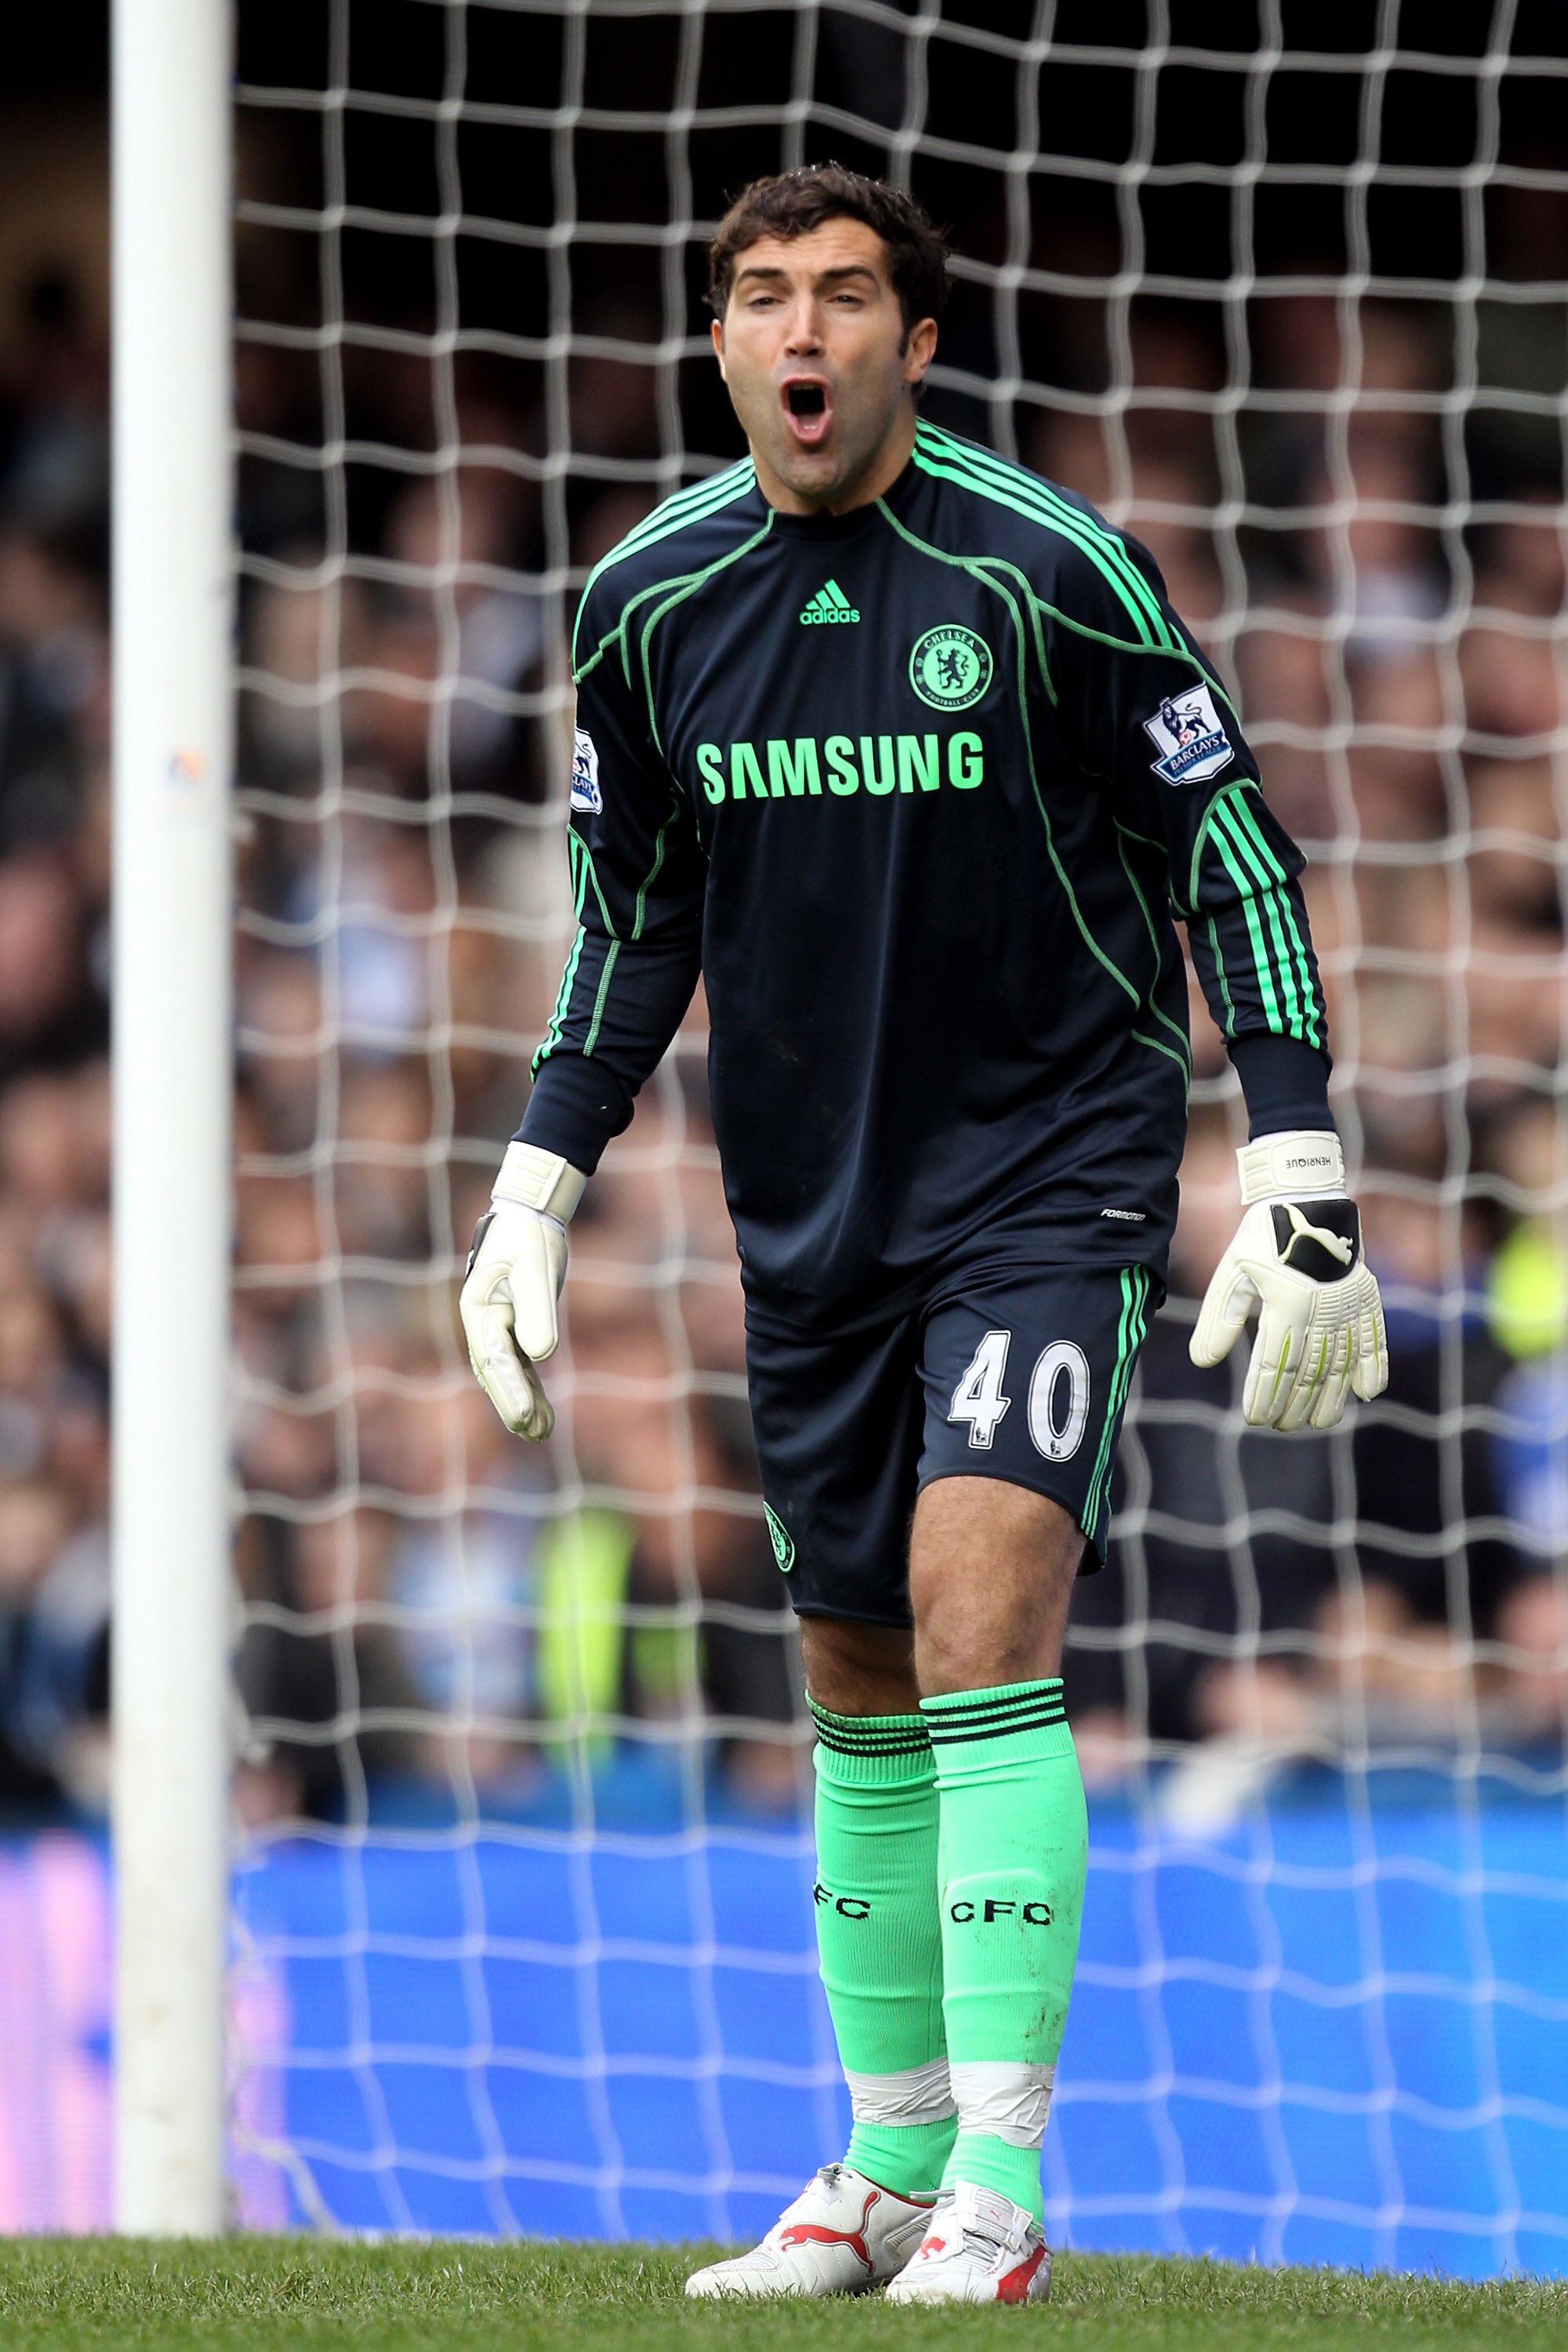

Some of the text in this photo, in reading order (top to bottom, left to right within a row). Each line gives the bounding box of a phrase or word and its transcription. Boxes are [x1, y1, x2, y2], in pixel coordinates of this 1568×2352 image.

[800, 608, 860, 625] adidas
[924, 630, 975, 649] CHELSEA
[926, 691, 961, 706] FOOTBALL
[1170, 735, 1220, 771] BARCLAYS
[696, 731, 983, 804] SAMSUNG
[1286, 1156, 1331, 1169] HENRIQUE
[947, 1330, 1090, 1462] 40
[813, 1883, 870, 1920] FC
[951, 1900, 1051, 1926] CFC
